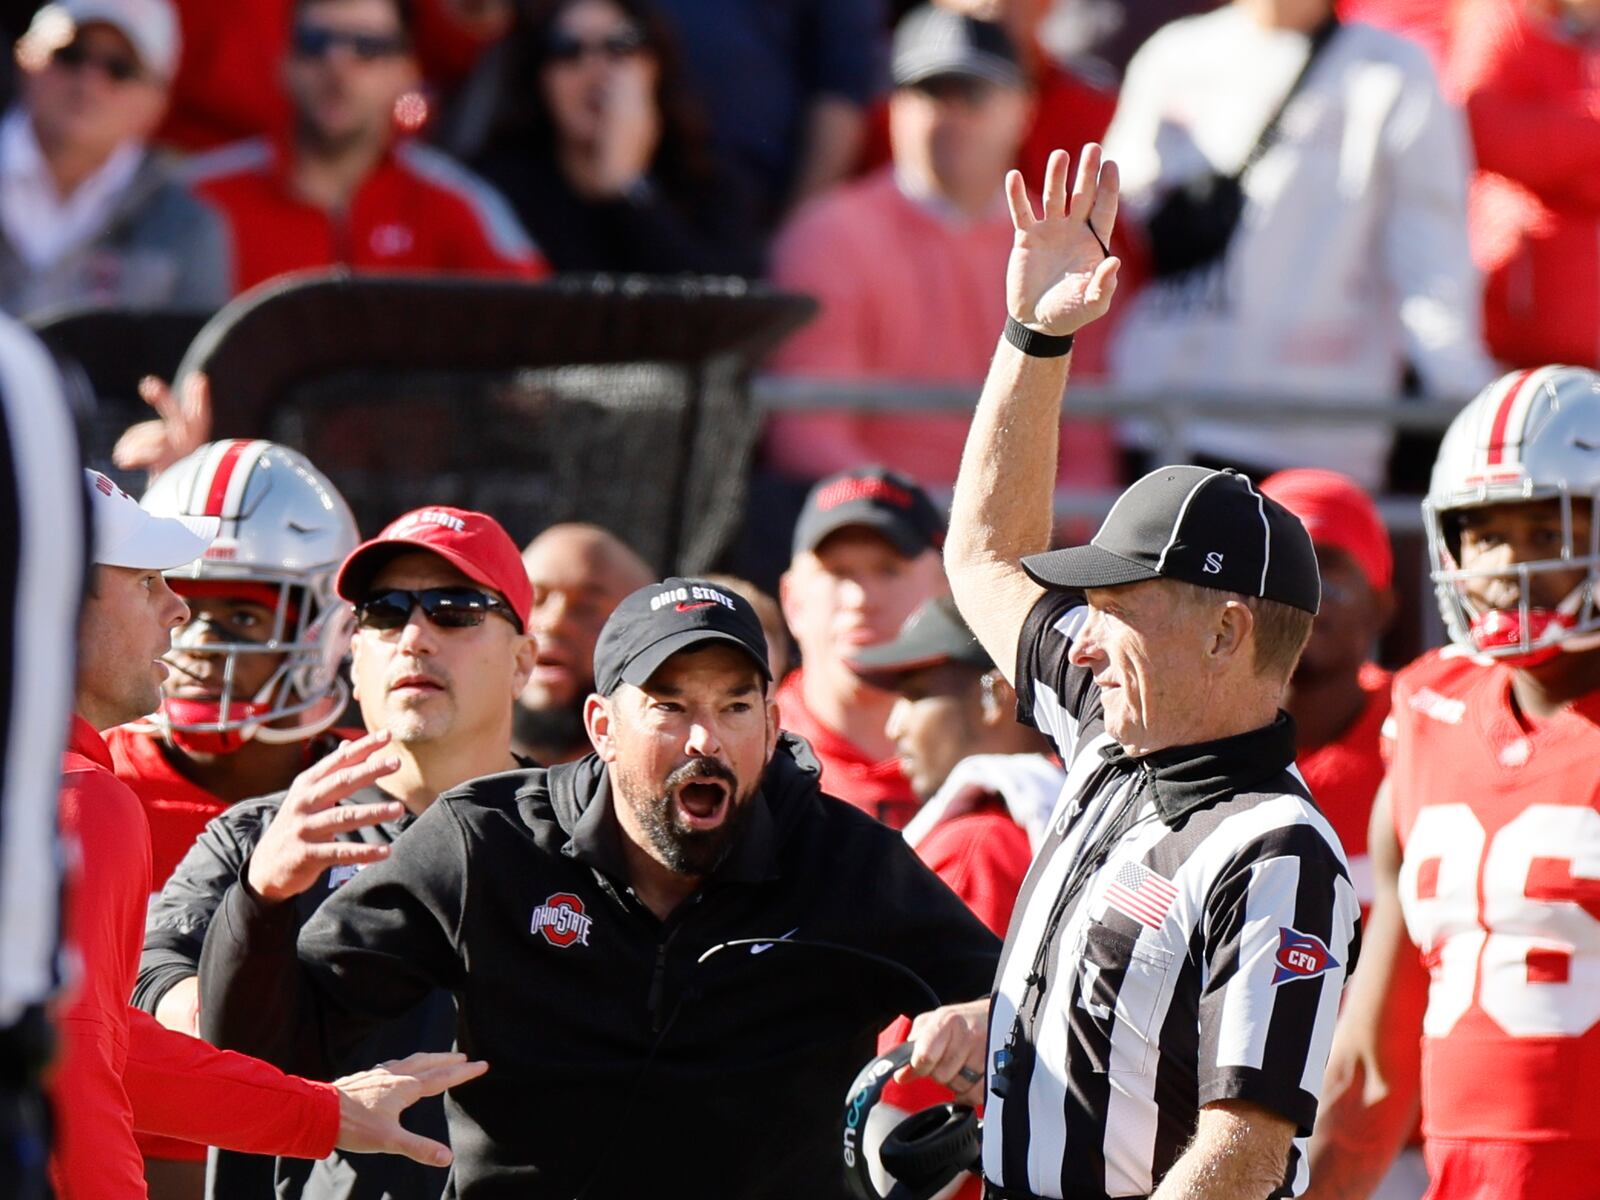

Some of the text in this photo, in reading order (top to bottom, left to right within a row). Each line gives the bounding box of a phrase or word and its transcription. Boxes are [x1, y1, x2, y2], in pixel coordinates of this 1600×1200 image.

[650, 586, 736, 611] OHIO STATE
[1288, 950, 1317, 972] CFO
